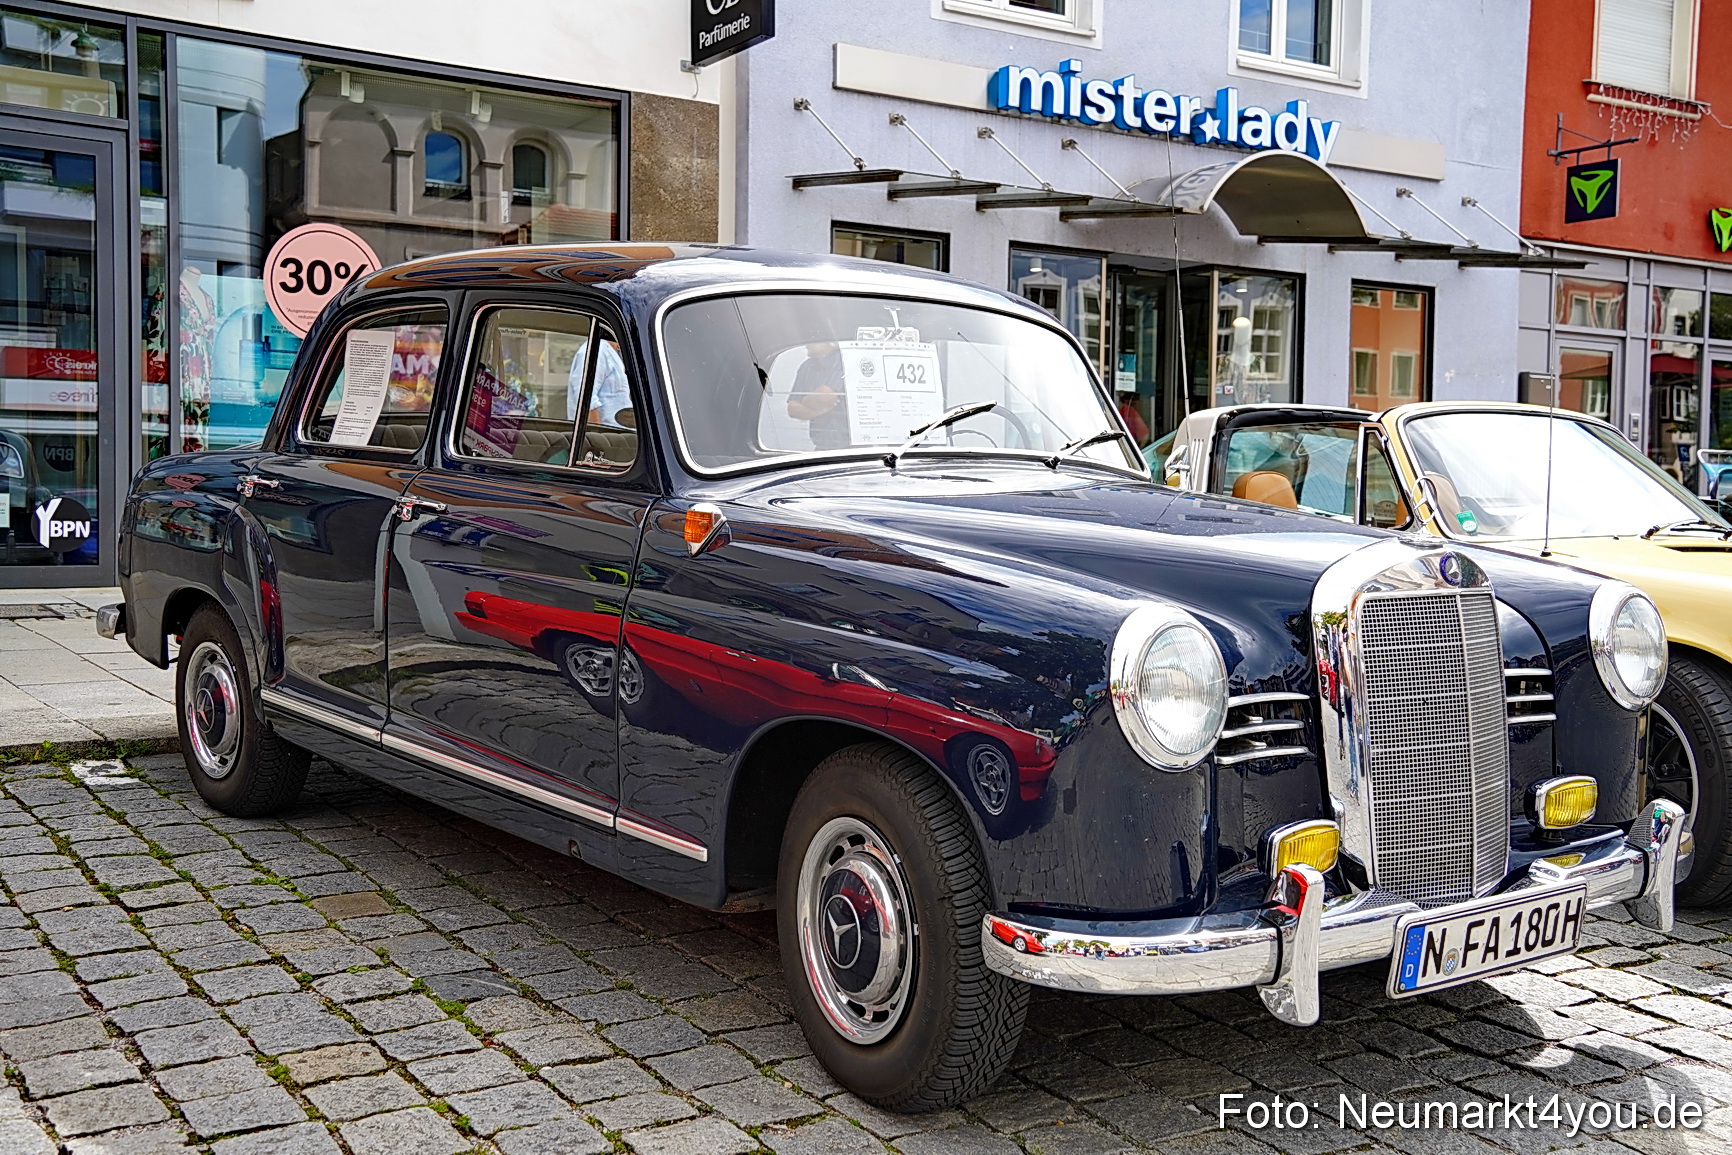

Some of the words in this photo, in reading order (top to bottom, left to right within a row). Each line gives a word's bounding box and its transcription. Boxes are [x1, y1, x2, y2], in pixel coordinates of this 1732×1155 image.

[699, 13, 750, 49] Parfümerie
[1000, 59, 1201, 134] mister
[1221, 87, 1342, 165] lady
[896, 363, 926, 384] 432
[1421, 928, 1447, 978] N
